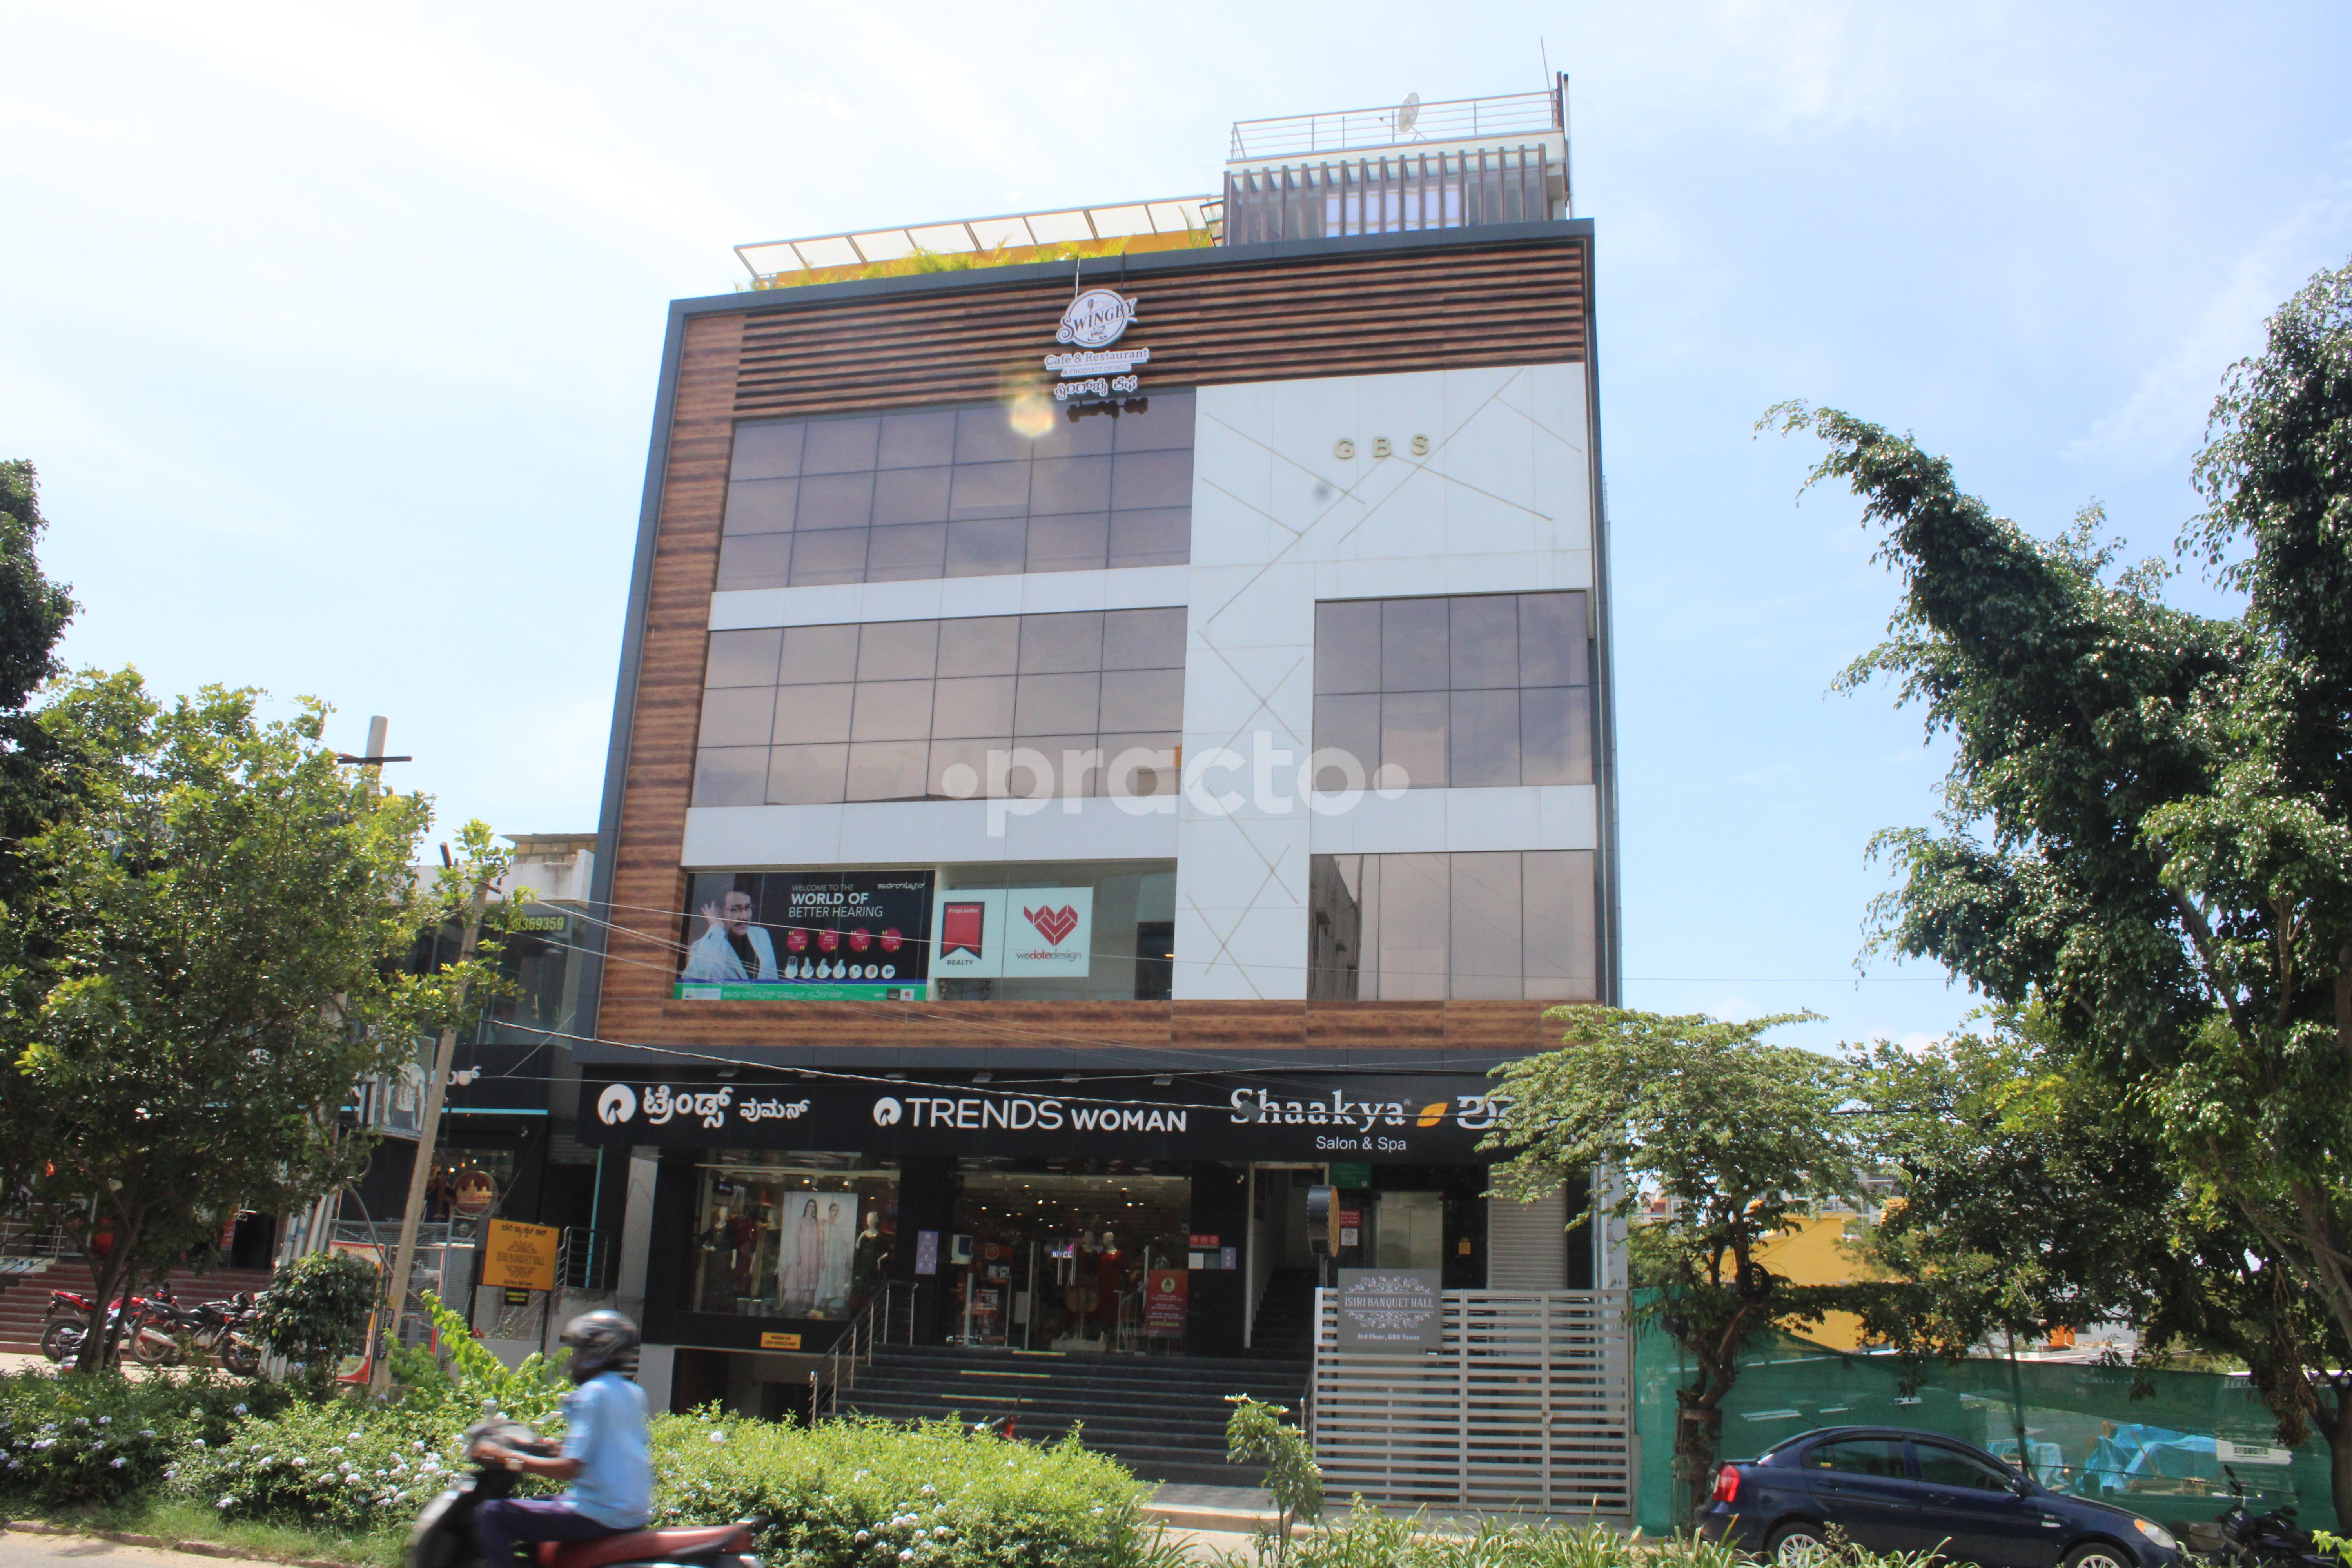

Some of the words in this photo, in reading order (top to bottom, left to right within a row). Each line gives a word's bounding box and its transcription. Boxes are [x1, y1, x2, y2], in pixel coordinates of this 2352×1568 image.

[1057, 299, 1136, 341] SWINGBY
[1046, 354, 1071, 365] Café
[1075, 354, 1082, 362] &
[1086, 350, 1147, 362] Restaurant
[791, 893, 844, 905] WORLD
[848, 893, 869, 904] OF
[789, 907, 829, 917] BETTER
[832, 906, 883, 917] HEARING
[1016, 949, 1081, 962] wedotedesign
[906, 1098, 1062, 1130] TRENDS
[1071, 1109, 1186, 1132] WOMAN
[1316, 1136, 1357, 1150] Salon
[1362, 1137, 1372, 1150] &
[1377, 1137, 1406, 1153] Spa
[1345, 1297, 1365, 1307] ISIRI
[1368, 1298, 1409, 1308] BANQUET
[1412, 1298, 1434, 1307] HALL
